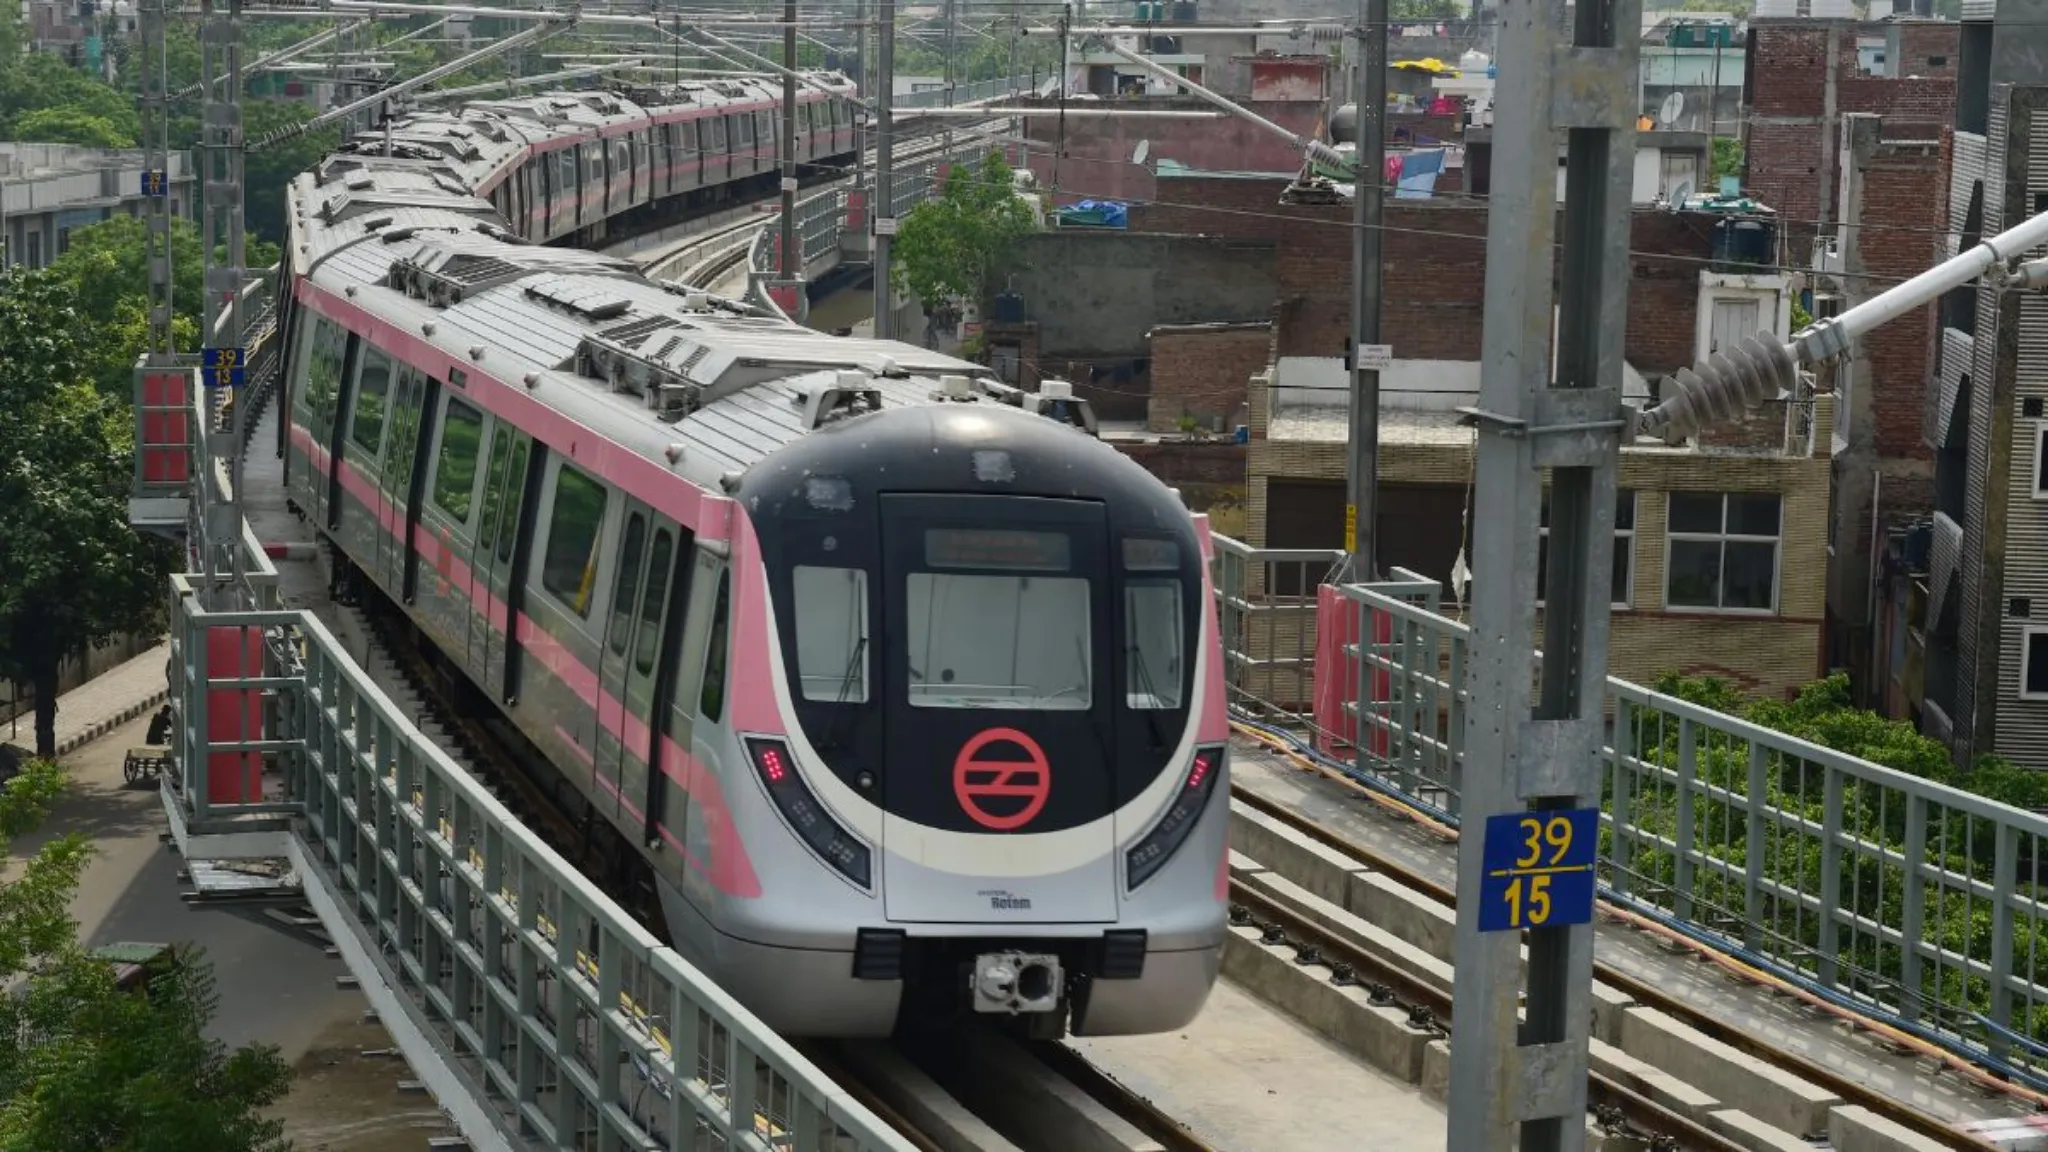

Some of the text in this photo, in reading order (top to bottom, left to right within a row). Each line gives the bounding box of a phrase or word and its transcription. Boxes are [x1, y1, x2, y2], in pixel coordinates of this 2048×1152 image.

[215, 350, 237, 366] 39
[215, 368, 232, 385] 13
[1516, 816, 1573, 868] 39
[1504, 875, 1551, 927] 15
